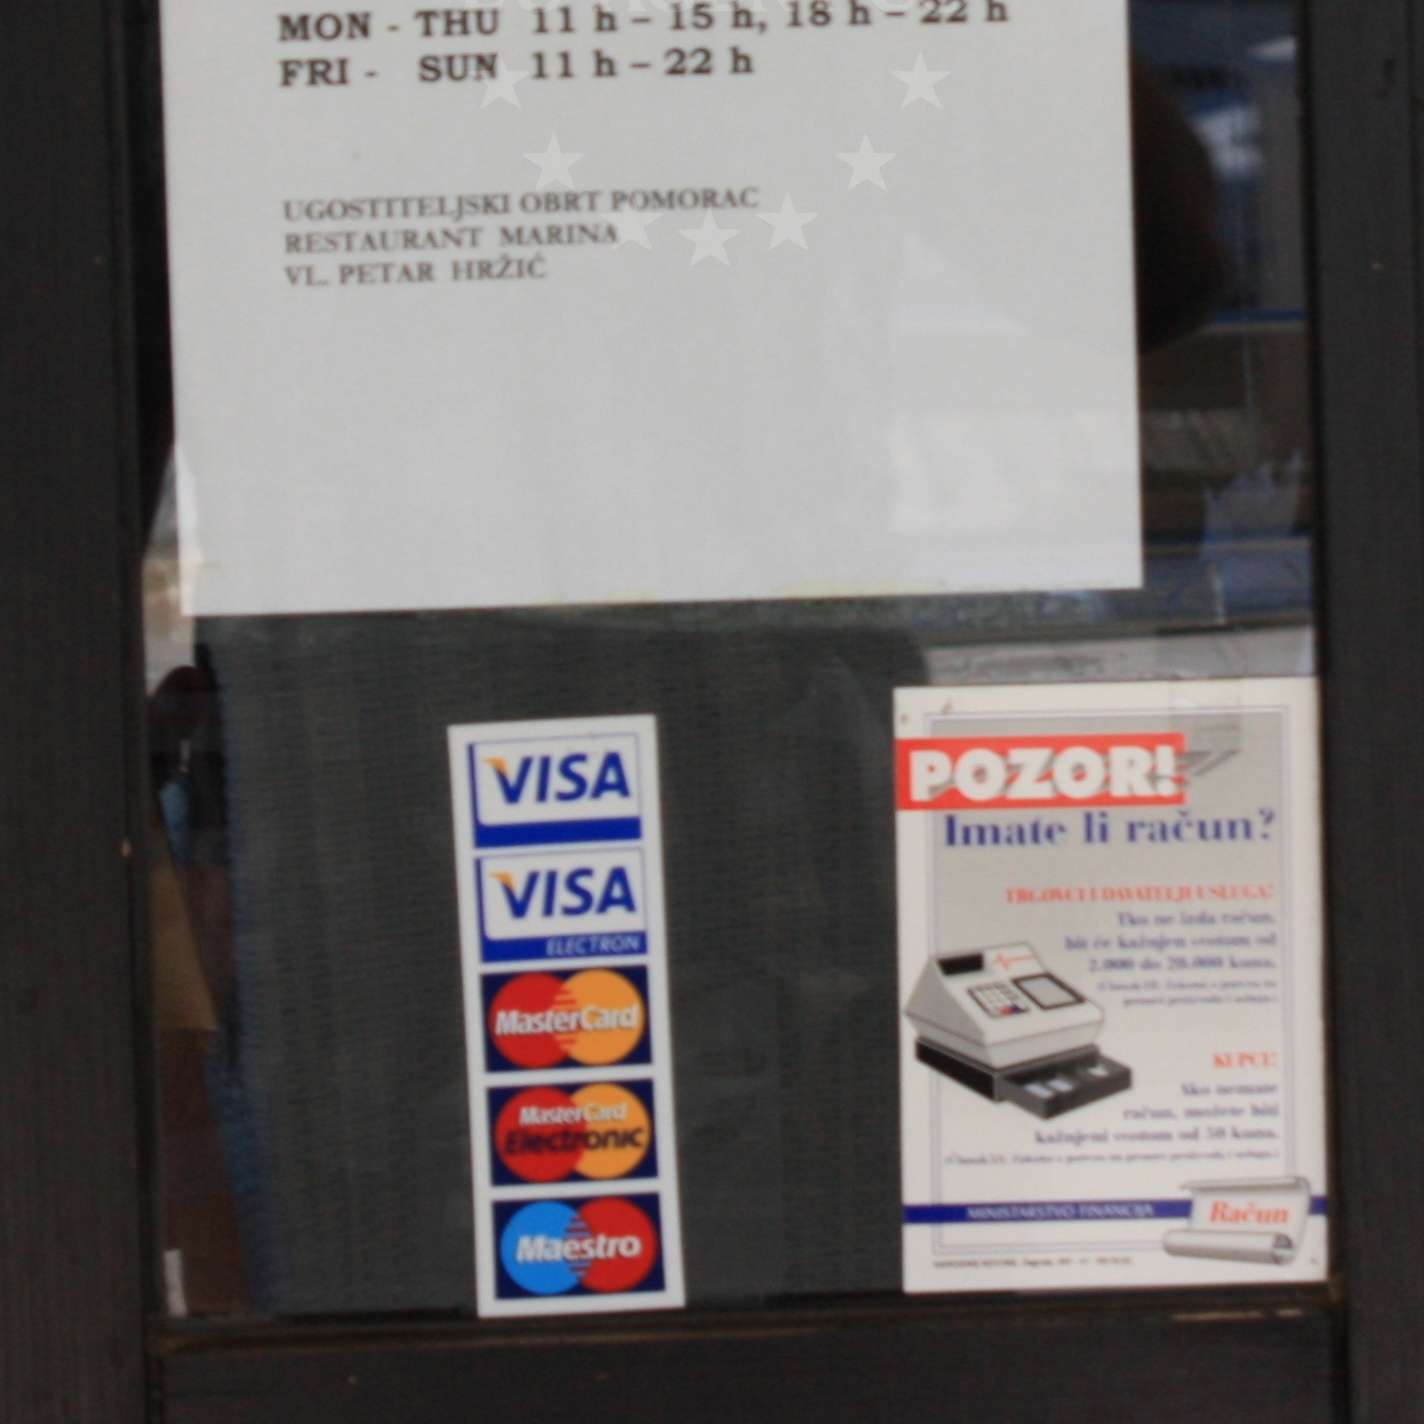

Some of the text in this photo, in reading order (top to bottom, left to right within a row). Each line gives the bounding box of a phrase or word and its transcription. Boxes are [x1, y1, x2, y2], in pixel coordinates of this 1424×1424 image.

[278, 12, 372, 42] MON
[415, 8, 501, 37] THU
[670, 2, 715, 31] 15
[787, 0, 832, 28] 18
[280, 57, 350, 88] FRI
[419, 53, 500, 83] SUN
[664, 47, 714, 76] 22
[283, 186, 761, 223] UGOSTITELJSKI OBRT POMORAC
[285, 223, 619, 256] RESTAURANT MARINA
[285, 252, 548, 287] VL. PETAR HRŽIĆ
[482, 752, 632, 805] VISA
[909, 744, 1176, 803] POZOR!
[944, 807, 1276, 848] Imate li račun?
[489, 866, 637, 919] VISA
[546, 934, 641, 957] ELECTRON
[495, 1004, 641, 1036] MasterCard
[519, 1102, 629, 1126] MasterCard
[503, 1127, 644, 1156] Electronic
[1209, 1199, 1290, 1225] Račun
[515, 1233, 643, 1264] Maestro
